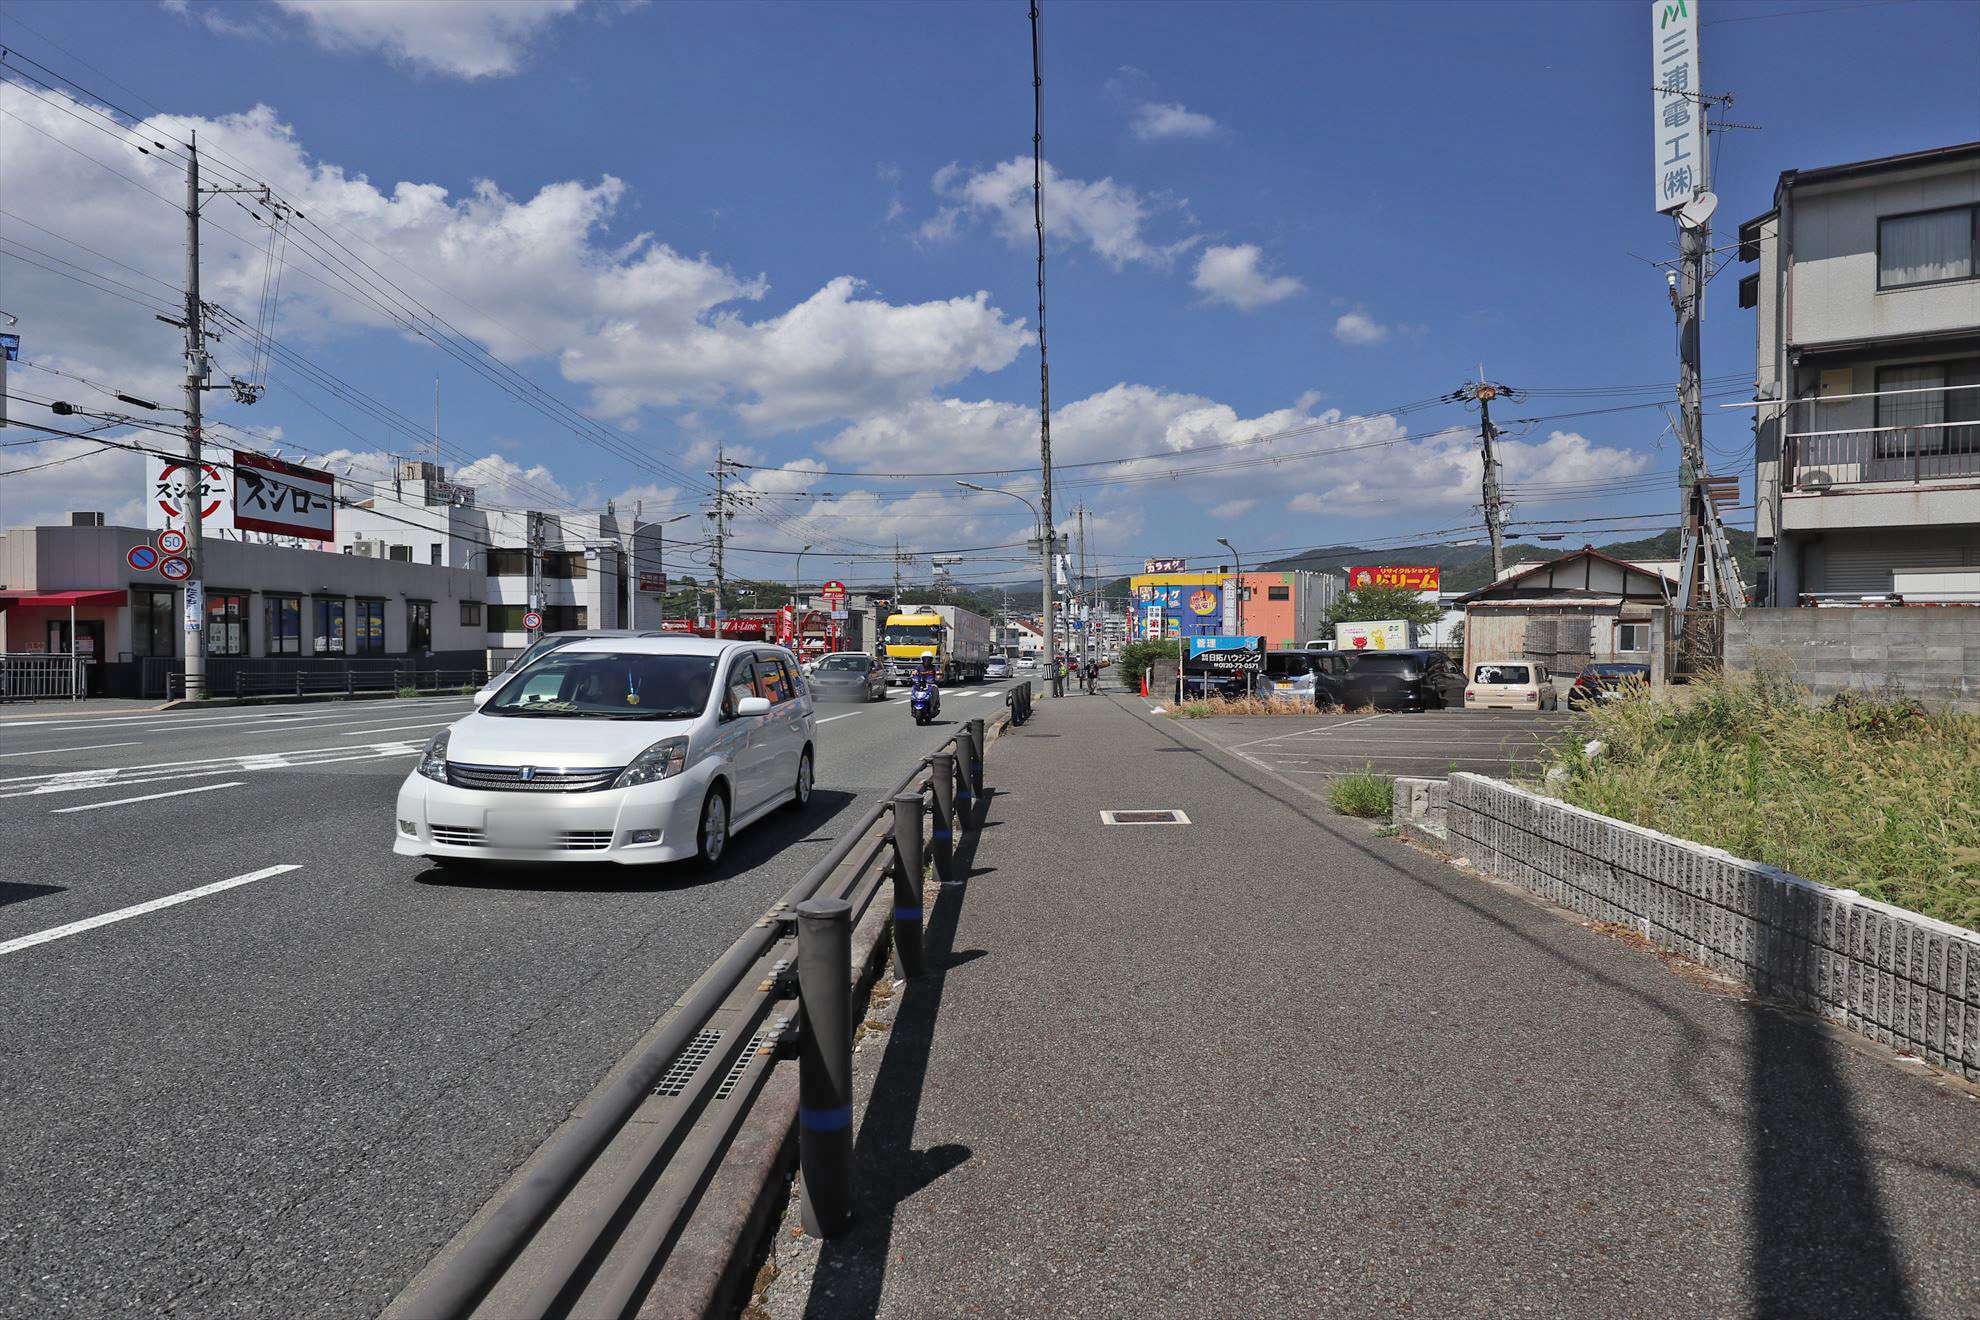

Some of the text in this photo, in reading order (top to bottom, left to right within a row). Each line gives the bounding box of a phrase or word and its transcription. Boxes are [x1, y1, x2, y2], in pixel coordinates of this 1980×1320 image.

[242, 476, 328, 514] スシロー
[164, 536, 181, 548] 50
[1146, 560, 1181, 573] カラオケ
[731, 621, 757, 631] A-Line
